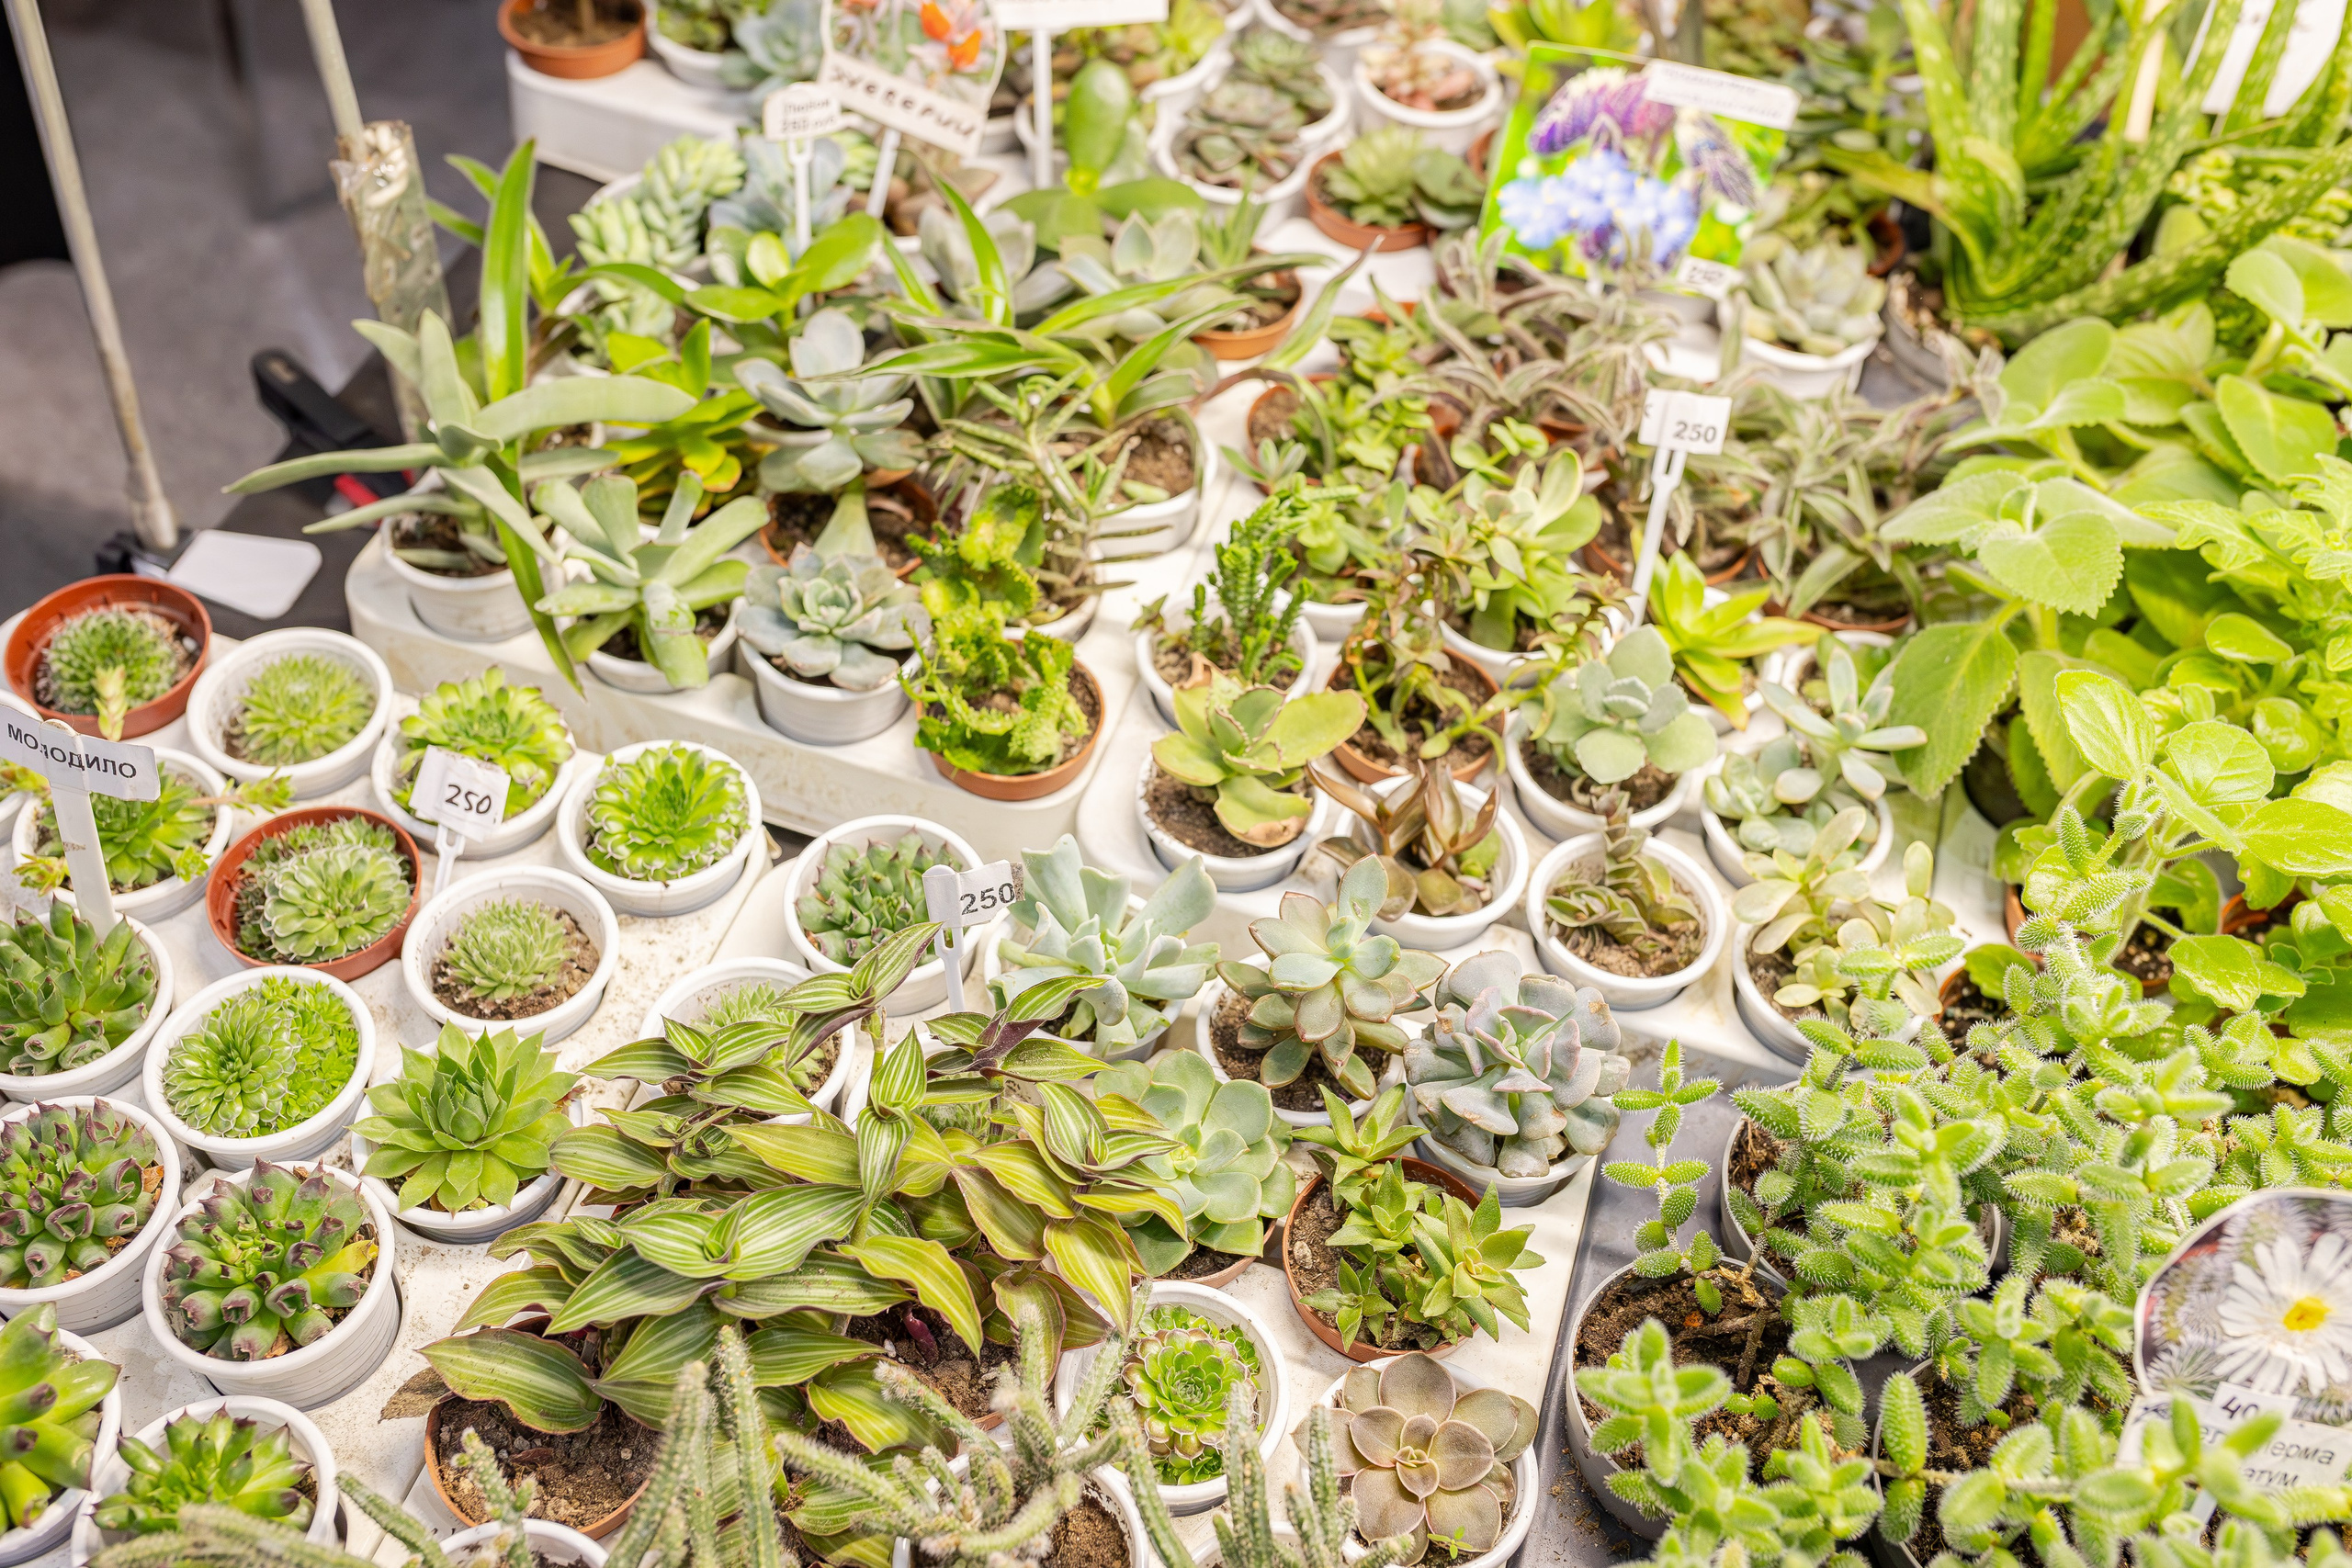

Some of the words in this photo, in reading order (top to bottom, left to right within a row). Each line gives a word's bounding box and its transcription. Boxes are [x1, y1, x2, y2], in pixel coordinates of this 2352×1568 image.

[1673, 420, 1717, 444] 250
[445, 784, 492, 815] 250
[959, 882, 1015, 916] 250
